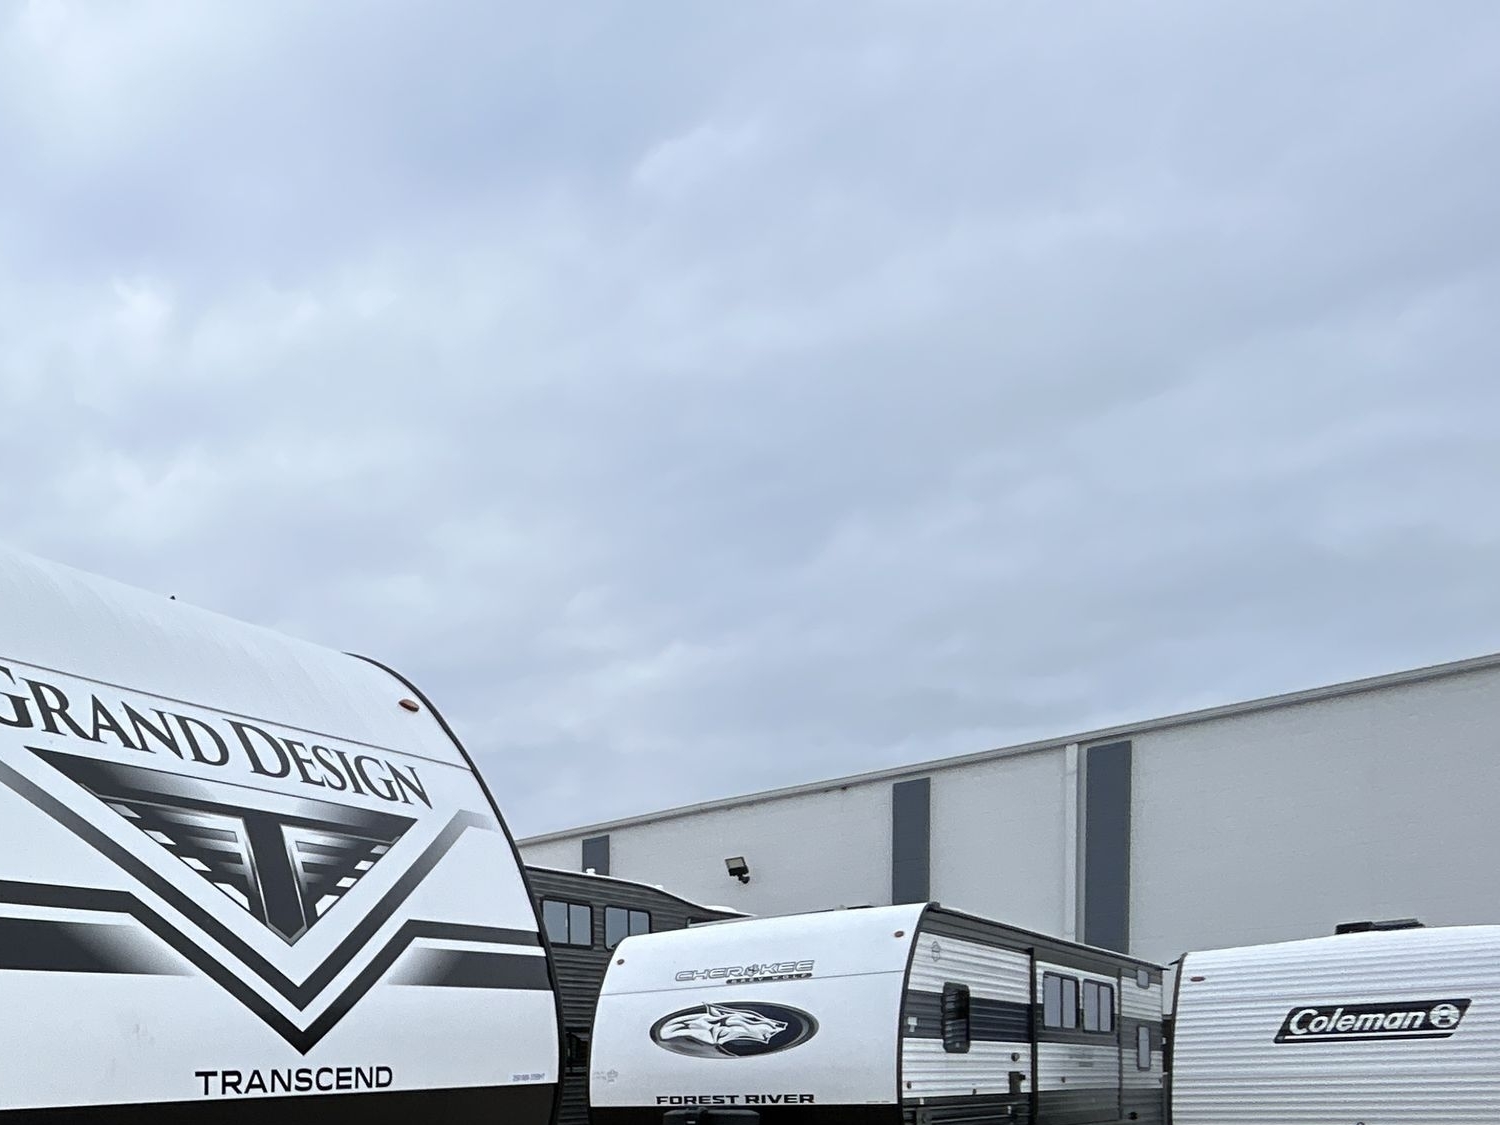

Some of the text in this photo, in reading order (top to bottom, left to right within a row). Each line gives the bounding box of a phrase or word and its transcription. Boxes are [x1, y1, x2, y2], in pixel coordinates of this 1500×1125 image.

[223, 718, 433, 809] DESIGN
[1289, 1008, 1426, 1035] Coleman
[195, 1066, 393, 1095] TRANSCEND
[656, 1093, 816, 1105] FOREST RIVER
